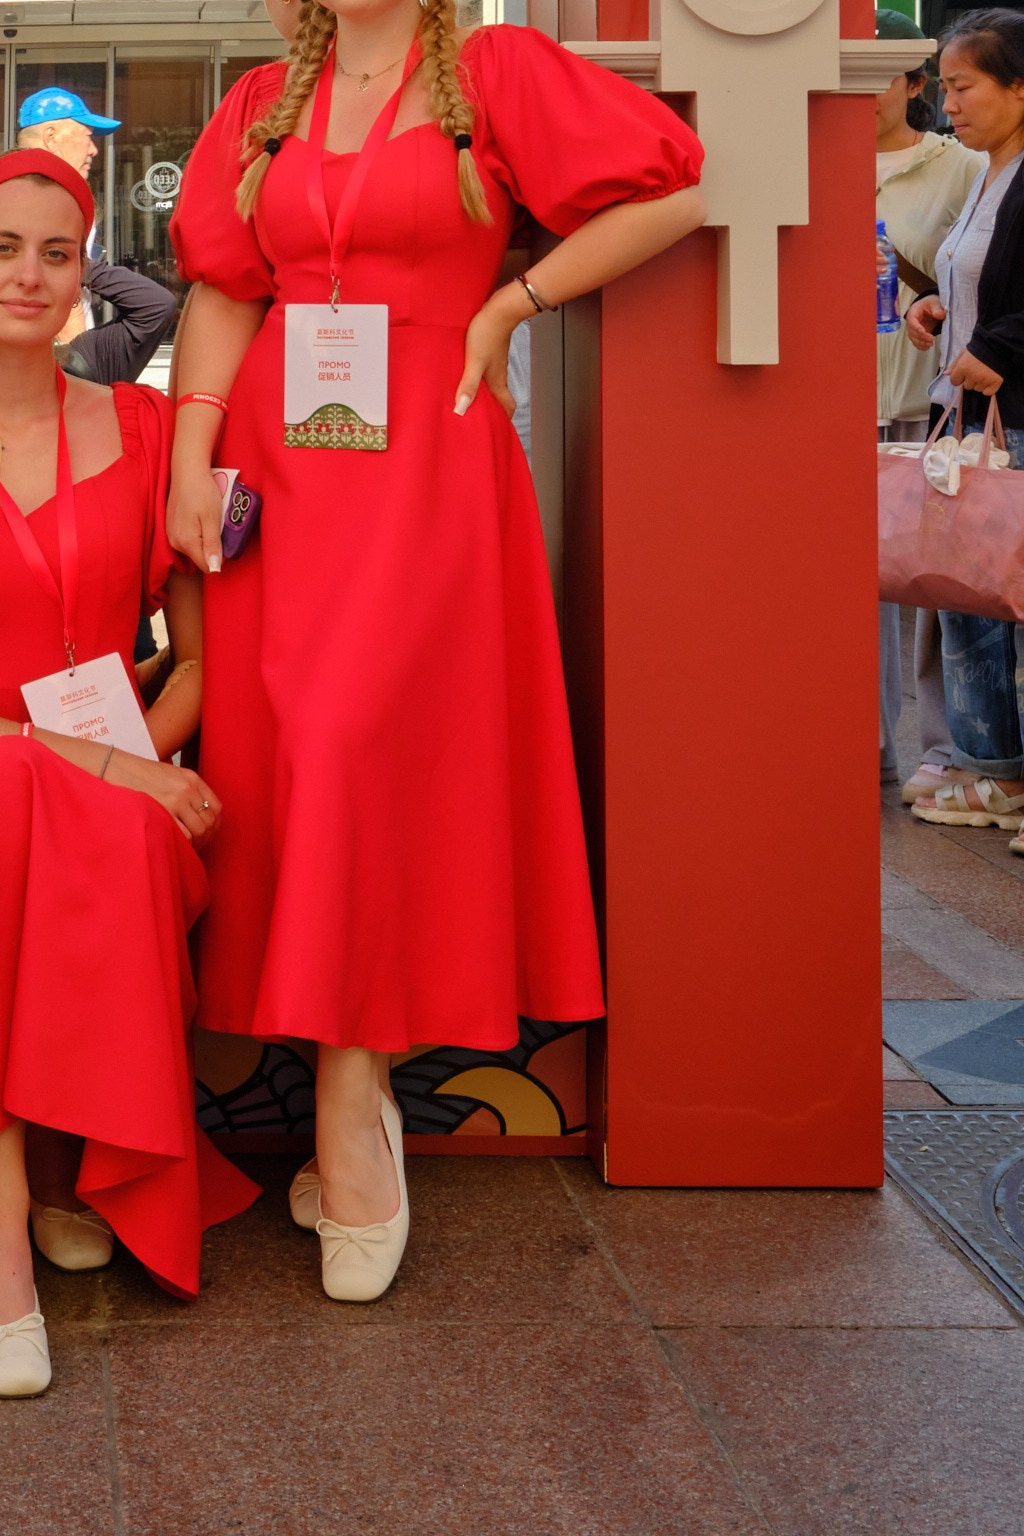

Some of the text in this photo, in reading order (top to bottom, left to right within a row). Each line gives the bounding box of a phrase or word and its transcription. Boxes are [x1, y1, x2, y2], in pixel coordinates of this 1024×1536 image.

[318, 361, 351, 369] ПРОМО
[318, 372, 351, 381] 促销人员
[72, 716, 105, 733] ПРОМО
